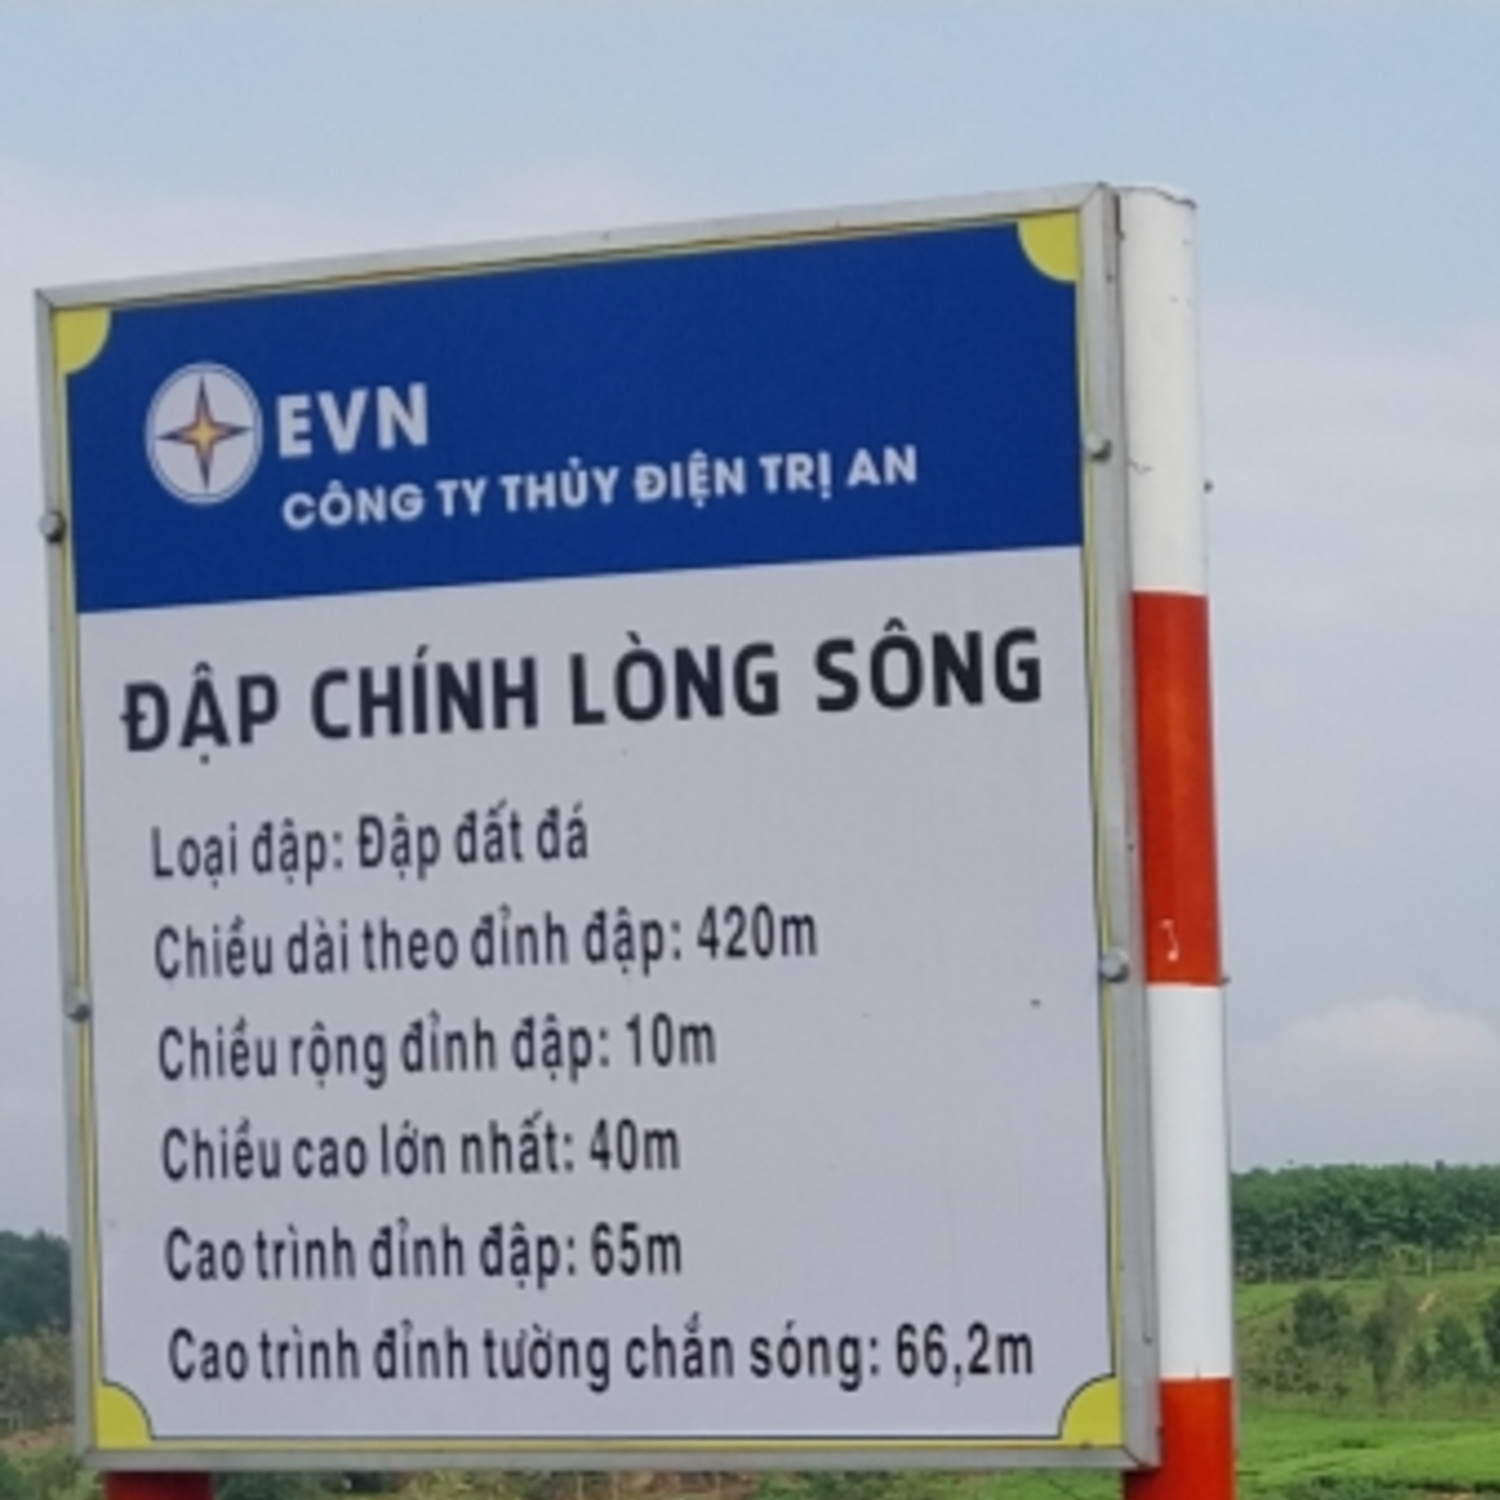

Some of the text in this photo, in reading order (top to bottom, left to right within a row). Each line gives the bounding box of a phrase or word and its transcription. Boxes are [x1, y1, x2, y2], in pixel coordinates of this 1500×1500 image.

[278, 383, 427, 457] EVN
[283, 446, 916, 528] CÔNG TY THỦY ĐIỆN TRỊ AN
[119, 616, 1042, 765] ĐẬP CHÍNH LÒNG SÔNG
[151, 799, 588, 889] Loại đập: Đập đất đá
[154, 902, 818, 981] Chiều dài theo đỉnh đập: 420m
[158, 1009, 716, 1091] Chiều rộng đỉnh đập: 10m
[161, 1110, 680, 1183] Chiều cao lớn nhất: 40m
[164, 1216, 682, 1291] Cao trình đỉnh đập: 65m
[168, 1311, 1034, 1395] Cao trình đỉnh tường chắn sóng: 66,2m
